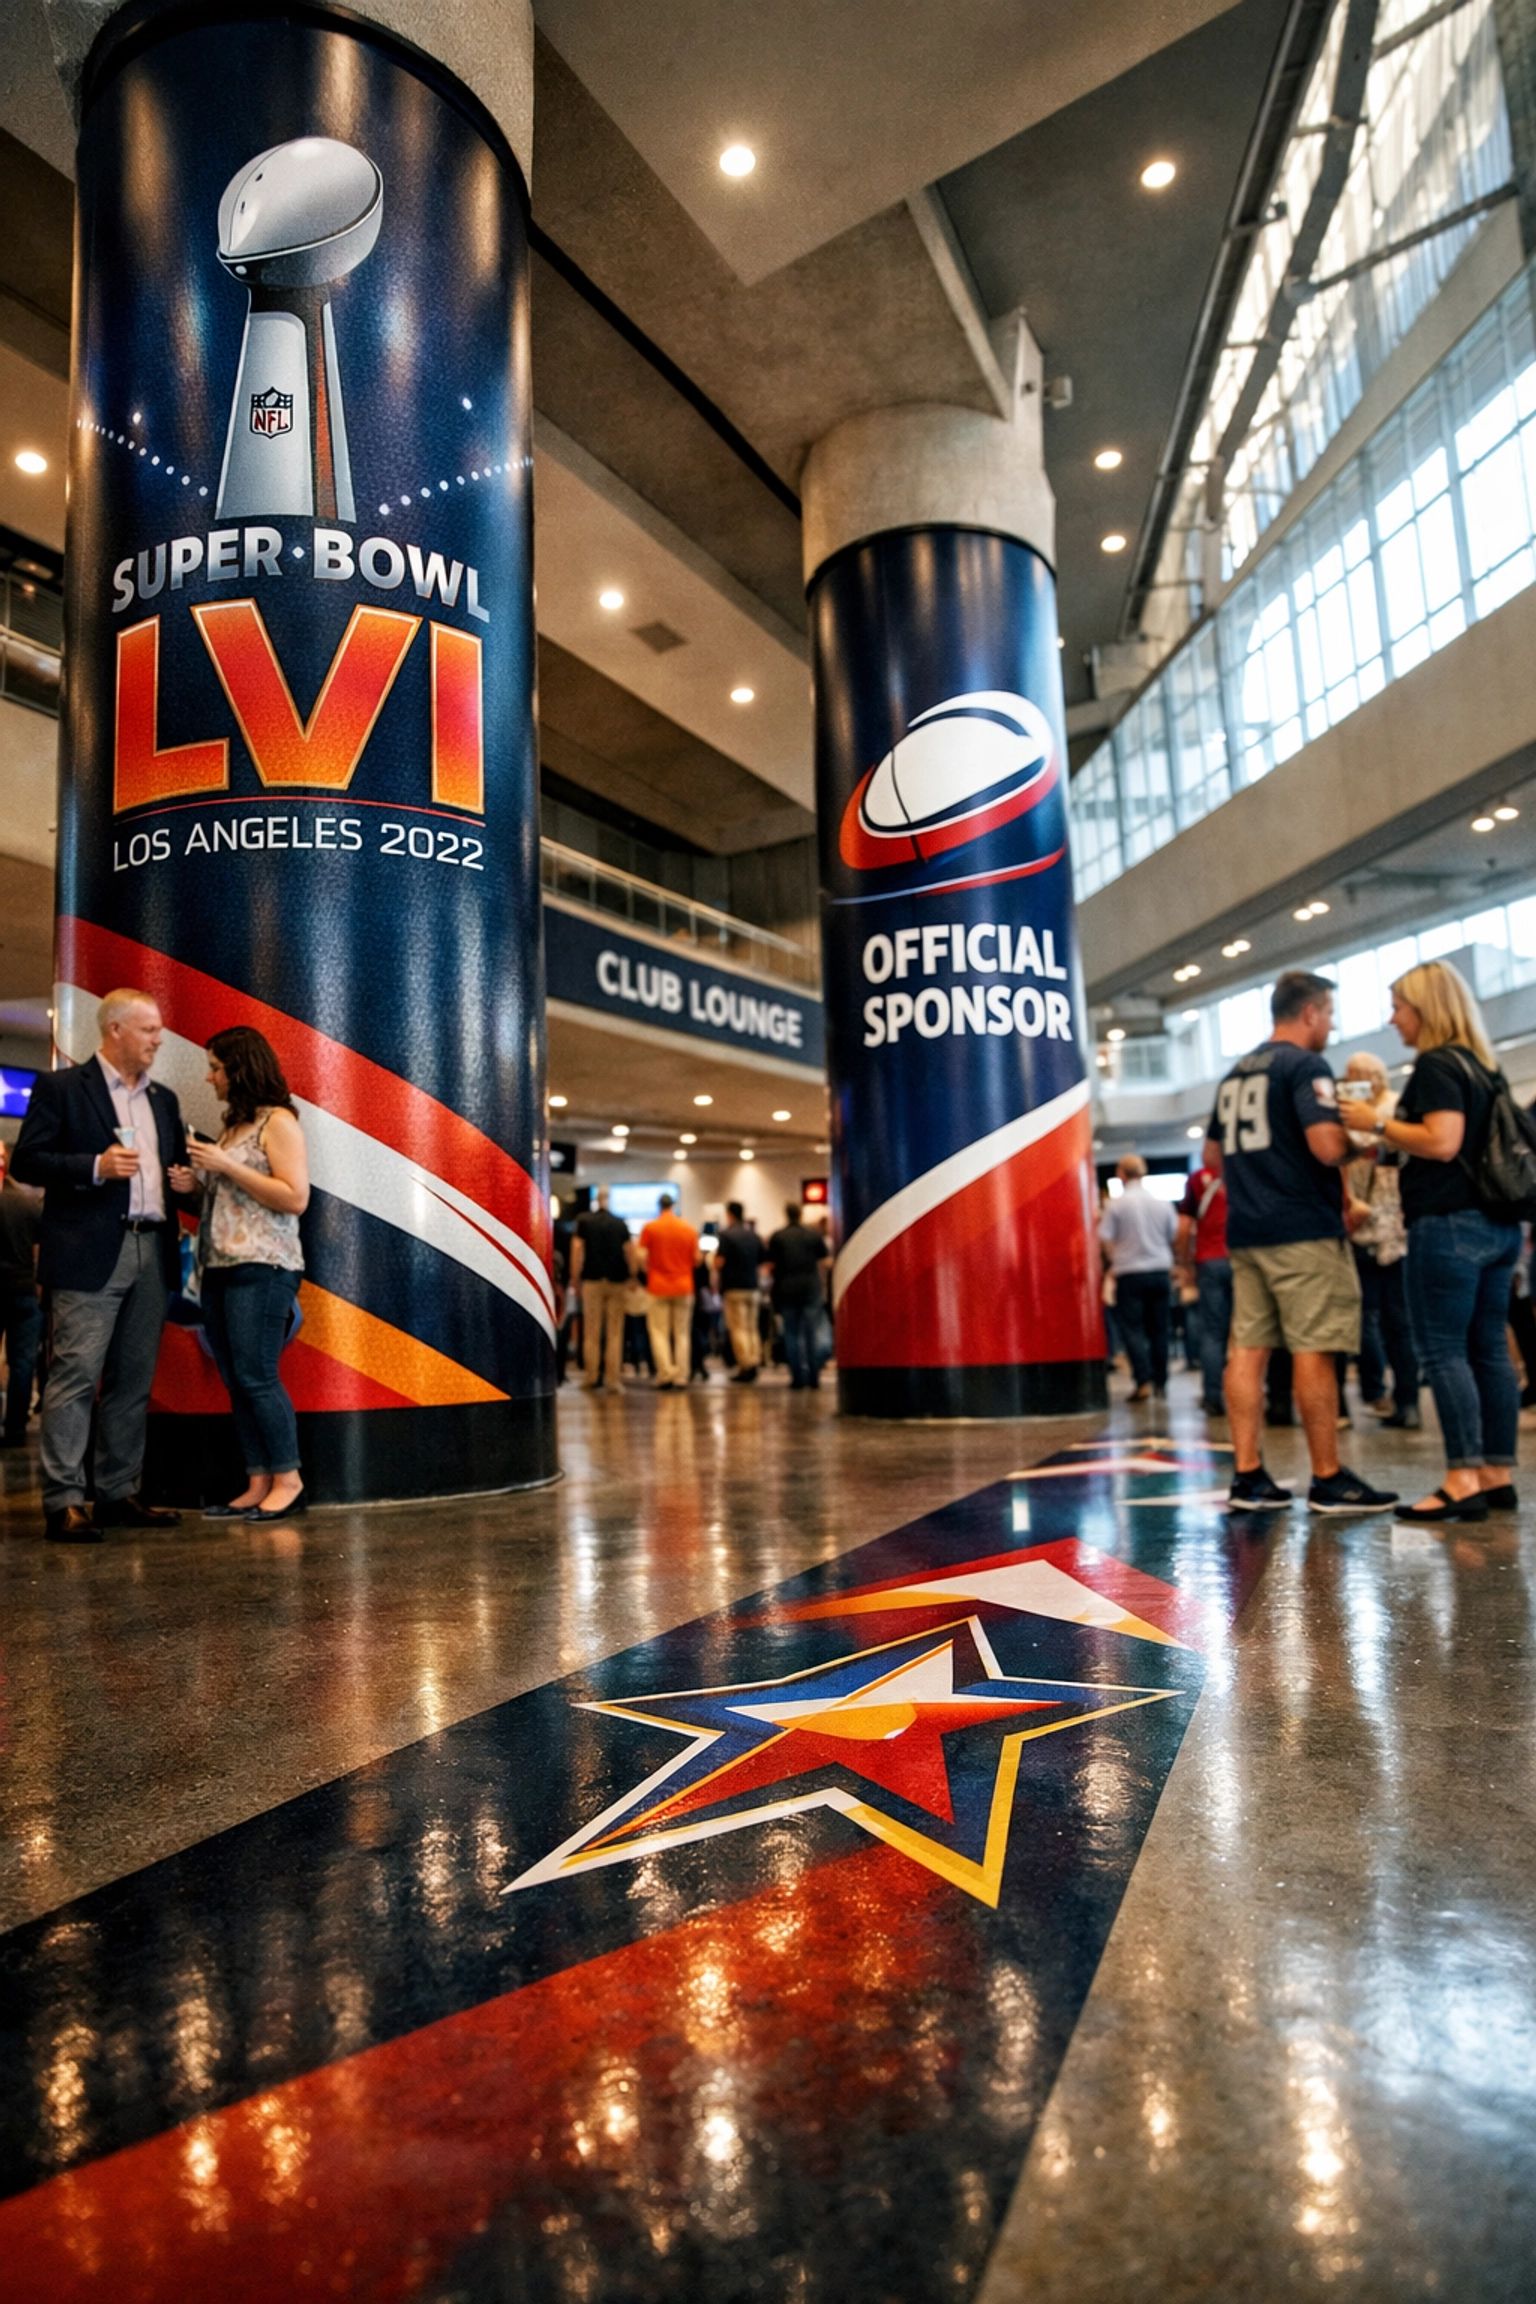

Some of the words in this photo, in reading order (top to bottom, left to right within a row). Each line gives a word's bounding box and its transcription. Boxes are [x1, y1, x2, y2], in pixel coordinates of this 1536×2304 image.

[253, 409, 289, 434] NFL
[112, 526, 284, 613] SUPER
[313, 527, 491, 623] BOWL
[112, 597, 485, 816] LVI
[113, 828, 171, 872] LOS
[184, 816, 363, 856] ANGELES
[380, 822, 485, 871] 2022
[862, 922, 1068, 985] OFFICIAL
[596, 949, 682, 1015] CLUB
[691, 979, 804, 1048] LOUNGE
[862, 984, 1074, 1048] SPONSOR
